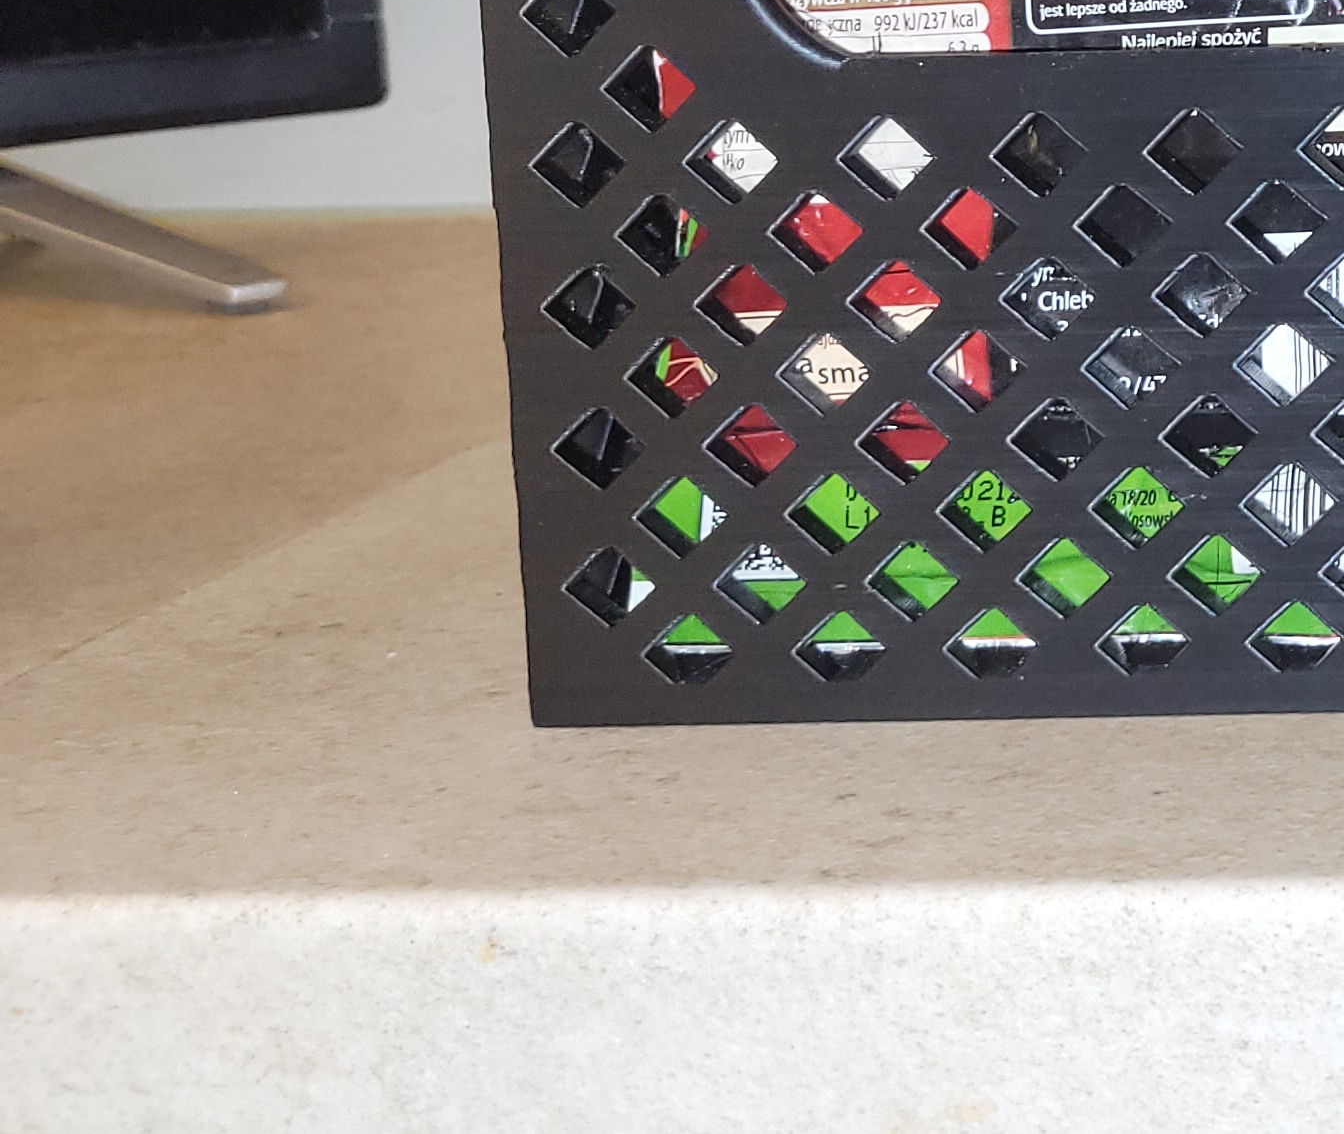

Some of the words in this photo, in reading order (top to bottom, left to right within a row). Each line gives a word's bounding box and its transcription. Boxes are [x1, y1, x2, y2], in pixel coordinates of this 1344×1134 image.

[874, 14, 900, 32] 992
[903, 11, 947, 31] kJ/237
[951, 8, 979, 29] kcal
[1038, 4, 1064, 21] jest
[1065, 2, 1107, 19] lepsze
